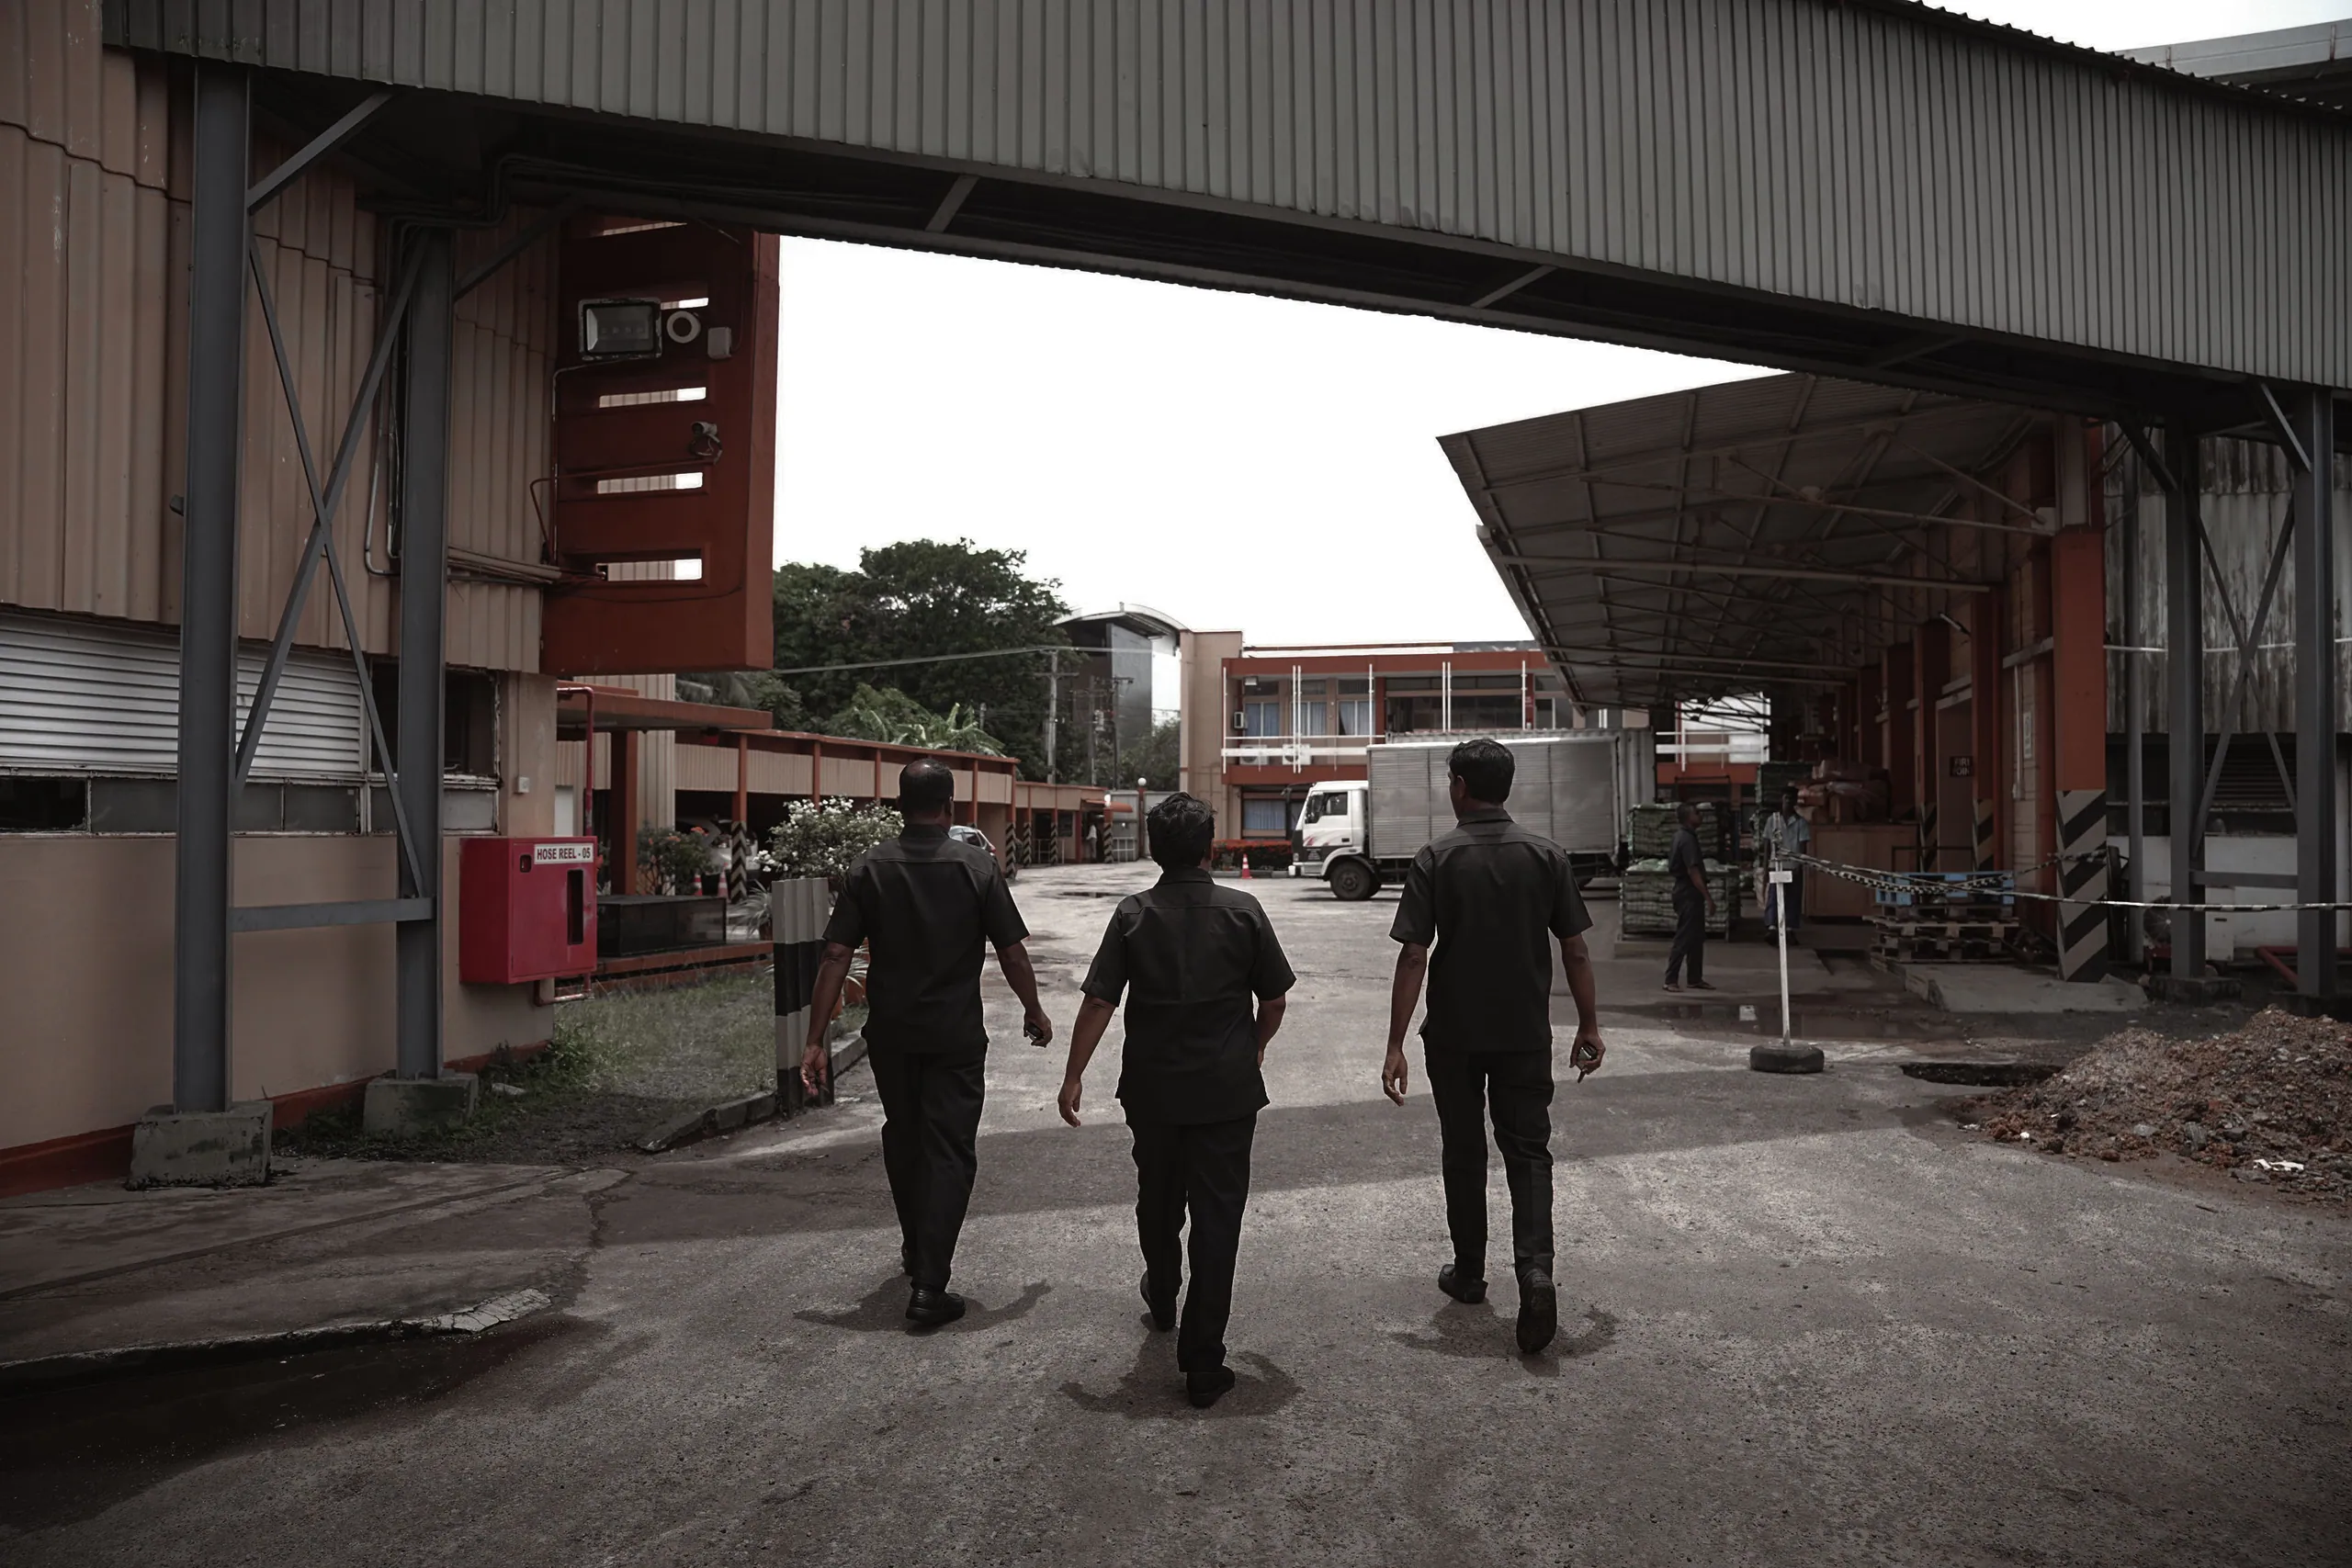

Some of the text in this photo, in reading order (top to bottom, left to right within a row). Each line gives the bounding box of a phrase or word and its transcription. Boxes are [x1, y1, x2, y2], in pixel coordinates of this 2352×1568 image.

[537, 848, 557, 860] HOSE
[559, 848, 576, 859] REEL
[582, 847, 591, 858] 05
